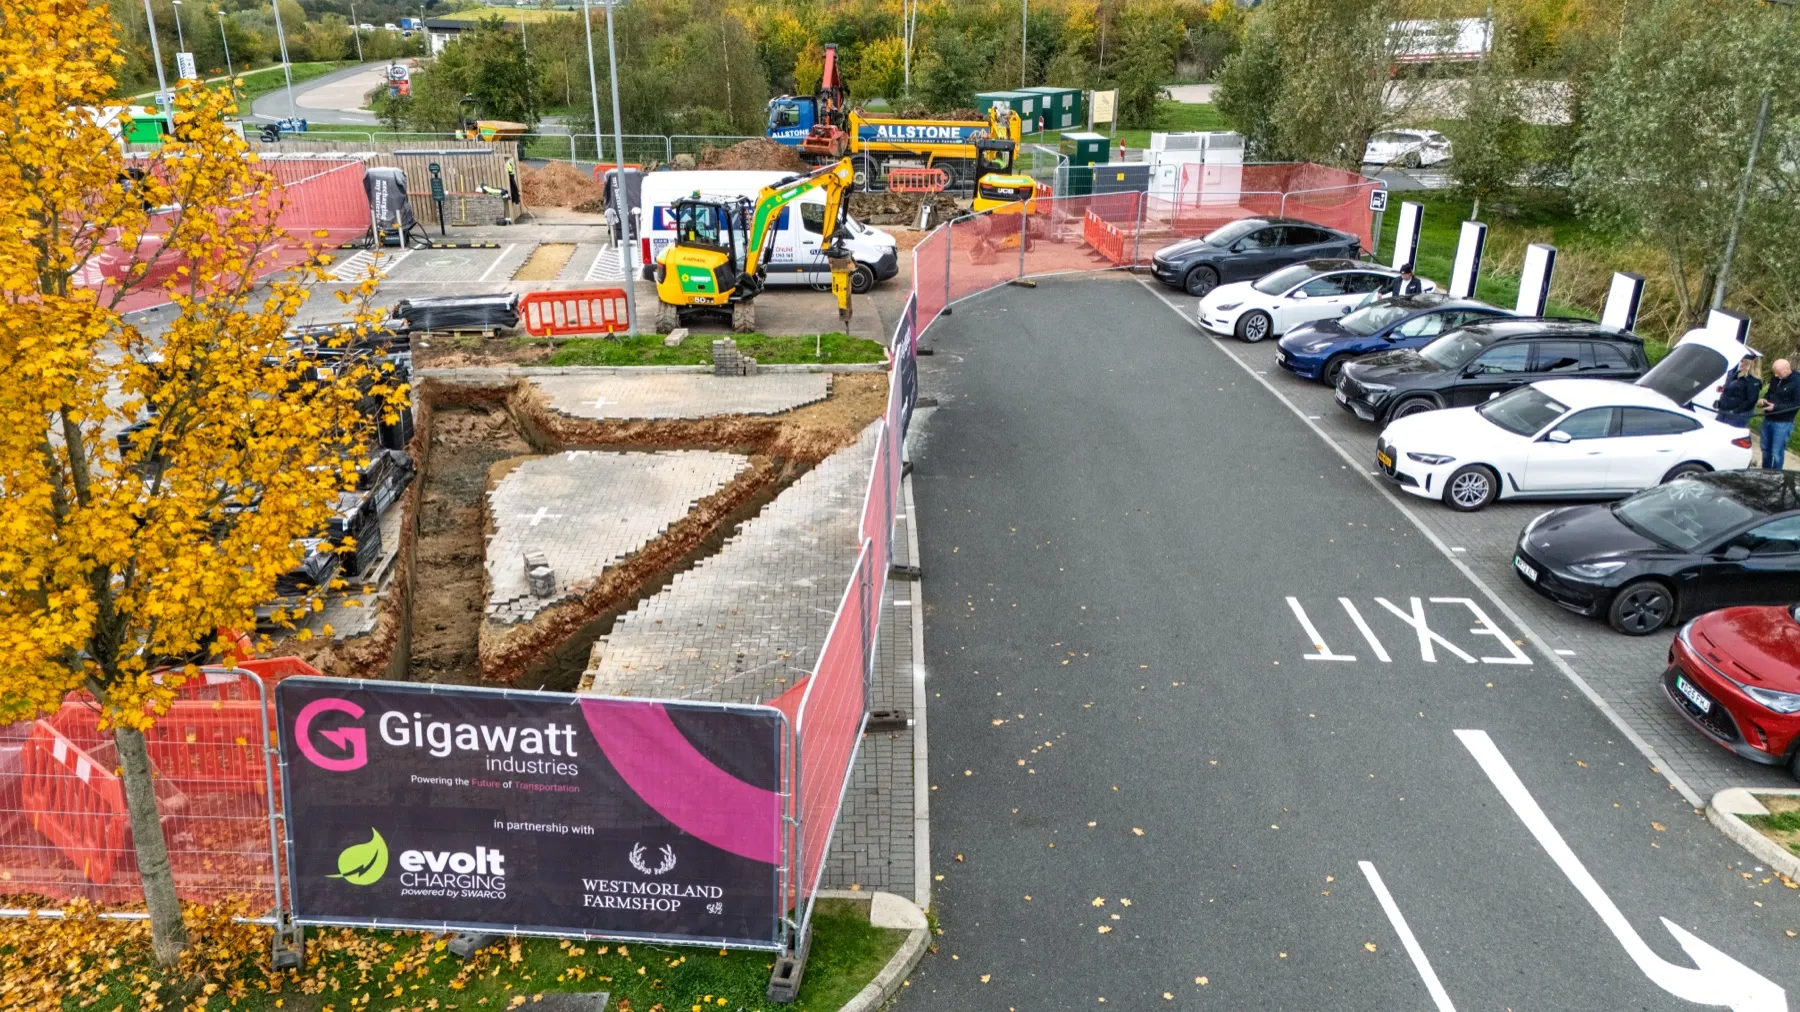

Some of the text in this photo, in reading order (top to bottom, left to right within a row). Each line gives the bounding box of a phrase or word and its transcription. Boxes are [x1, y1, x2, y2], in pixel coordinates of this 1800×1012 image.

[772, 129, 810, 138] ALLSTONE
[876, 125, 961, 138] ALLSTONE
[1285, 596, 1534, 664] EXIT
[379, 710, 578, 757] Gigawatt
[486, 754, 579, 776] industries
[410, 774, 580, 793] Powering the Future of Transportation
[493, 819, 595, 835] in partnership with
[399, 846, 506, 875] evolt
[400, 872, 506, 890] CHARGING
[582, 878, 723, 899] WESTMORLAND
[401, 887, 506, 900] powered by SWARCO
[583, 893, 681, 912] FARMSHOP
